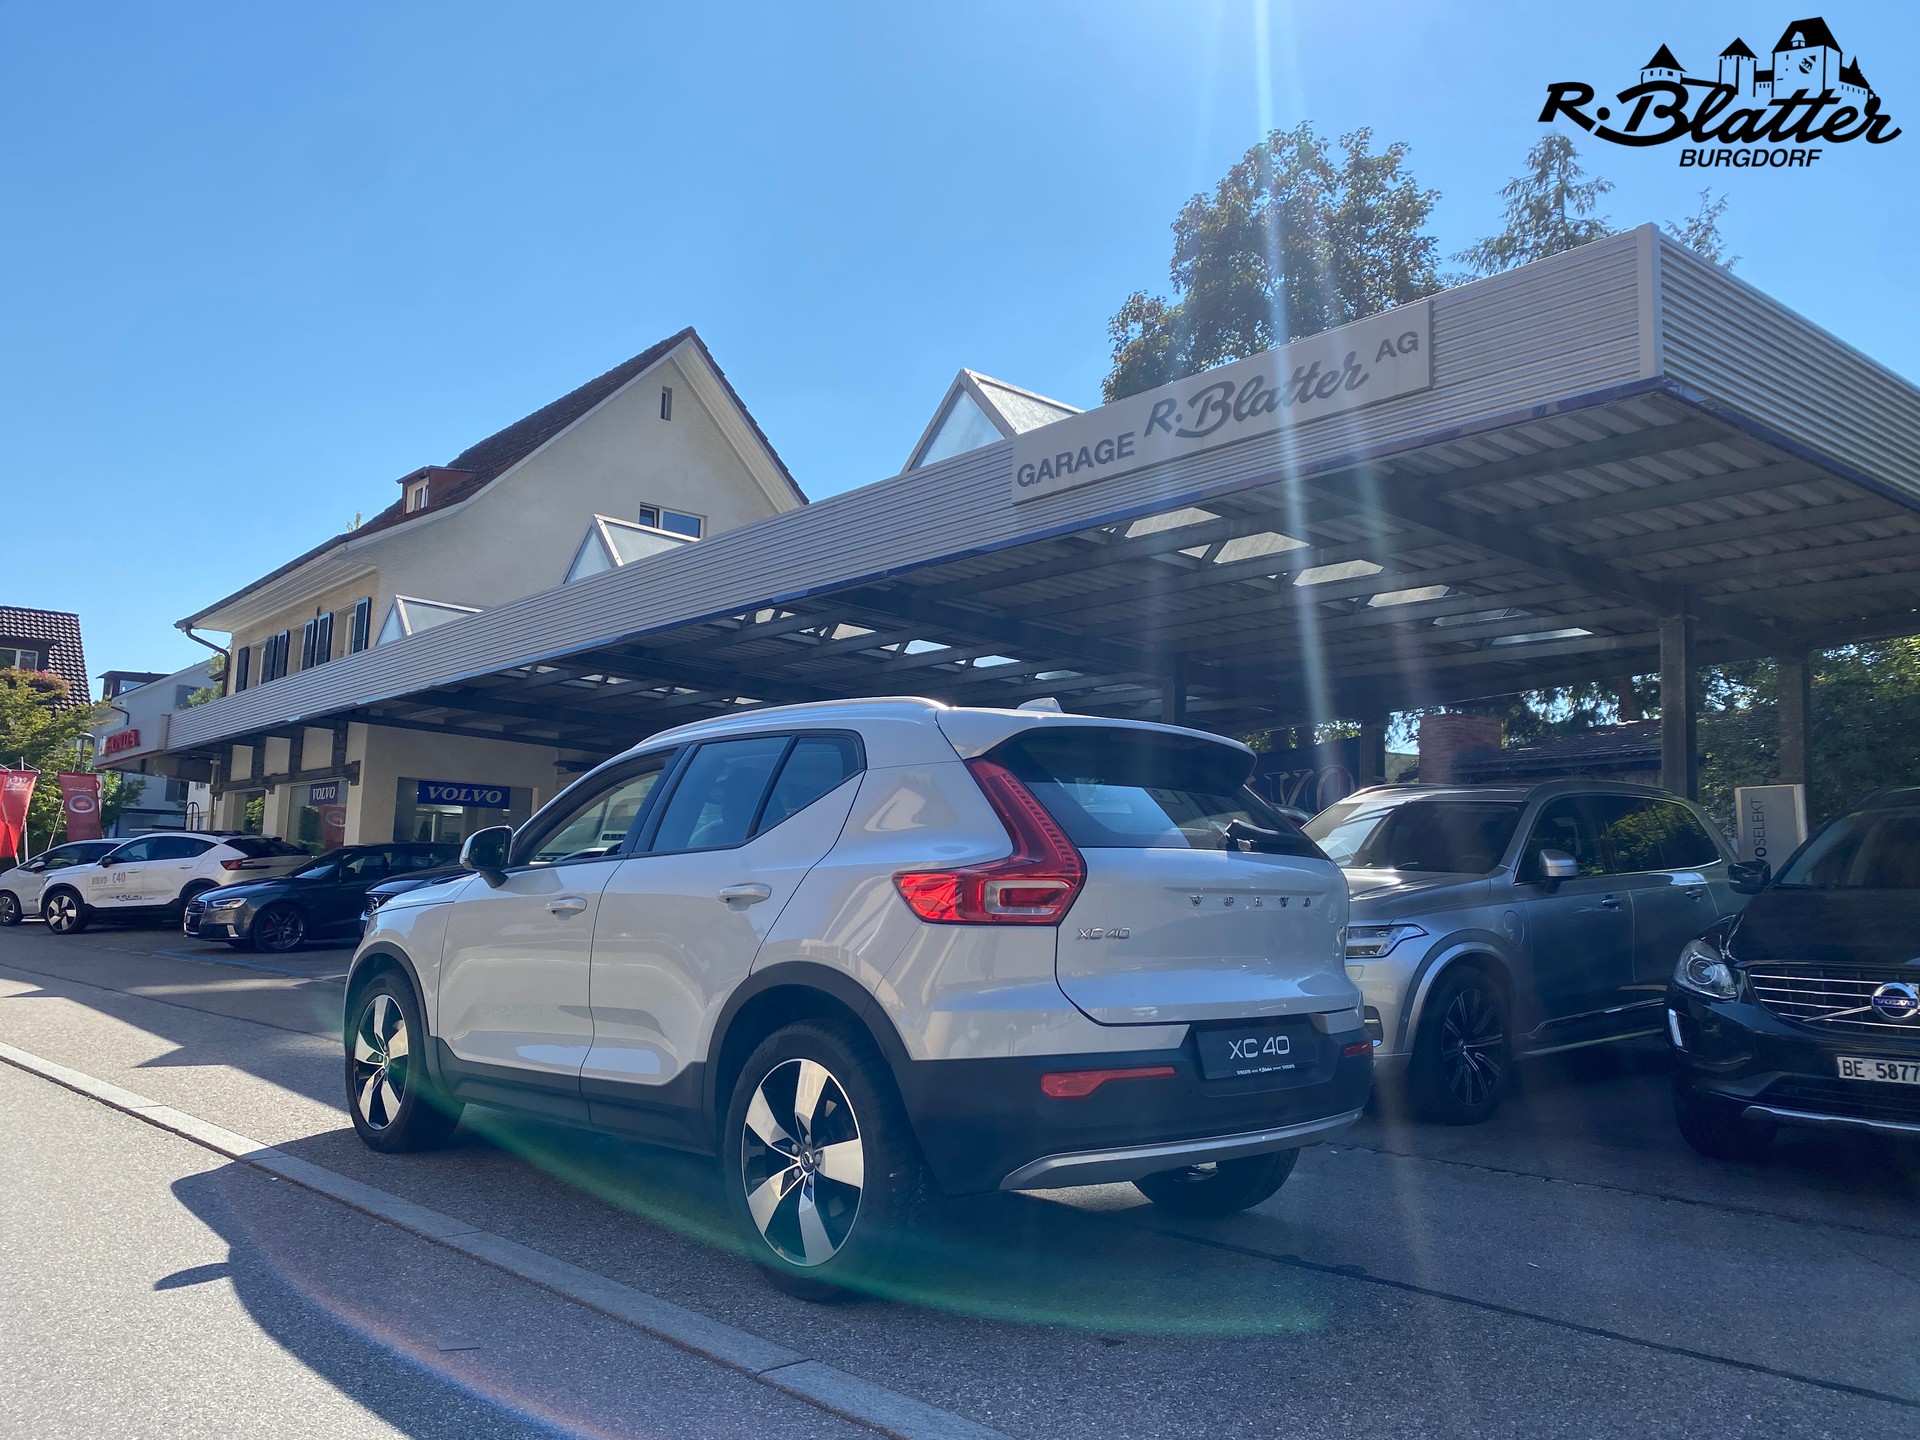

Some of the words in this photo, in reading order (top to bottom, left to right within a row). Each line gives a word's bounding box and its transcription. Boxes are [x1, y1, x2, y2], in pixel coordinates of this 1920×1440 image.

[1016, 431, 1135, 488] GARAGE
[1375, 331, 1420, 363] AG
[312, 786, 336, 801] VOLVO
[427, 786, 503, 804] VOLVO
[112, 872, 126, 884] C40
[1189, 895, 1311, 907] VOLVO
[1875, 997, 1916, 1007] VOLVO
[1842, 1060, 1865, 1078] BE
